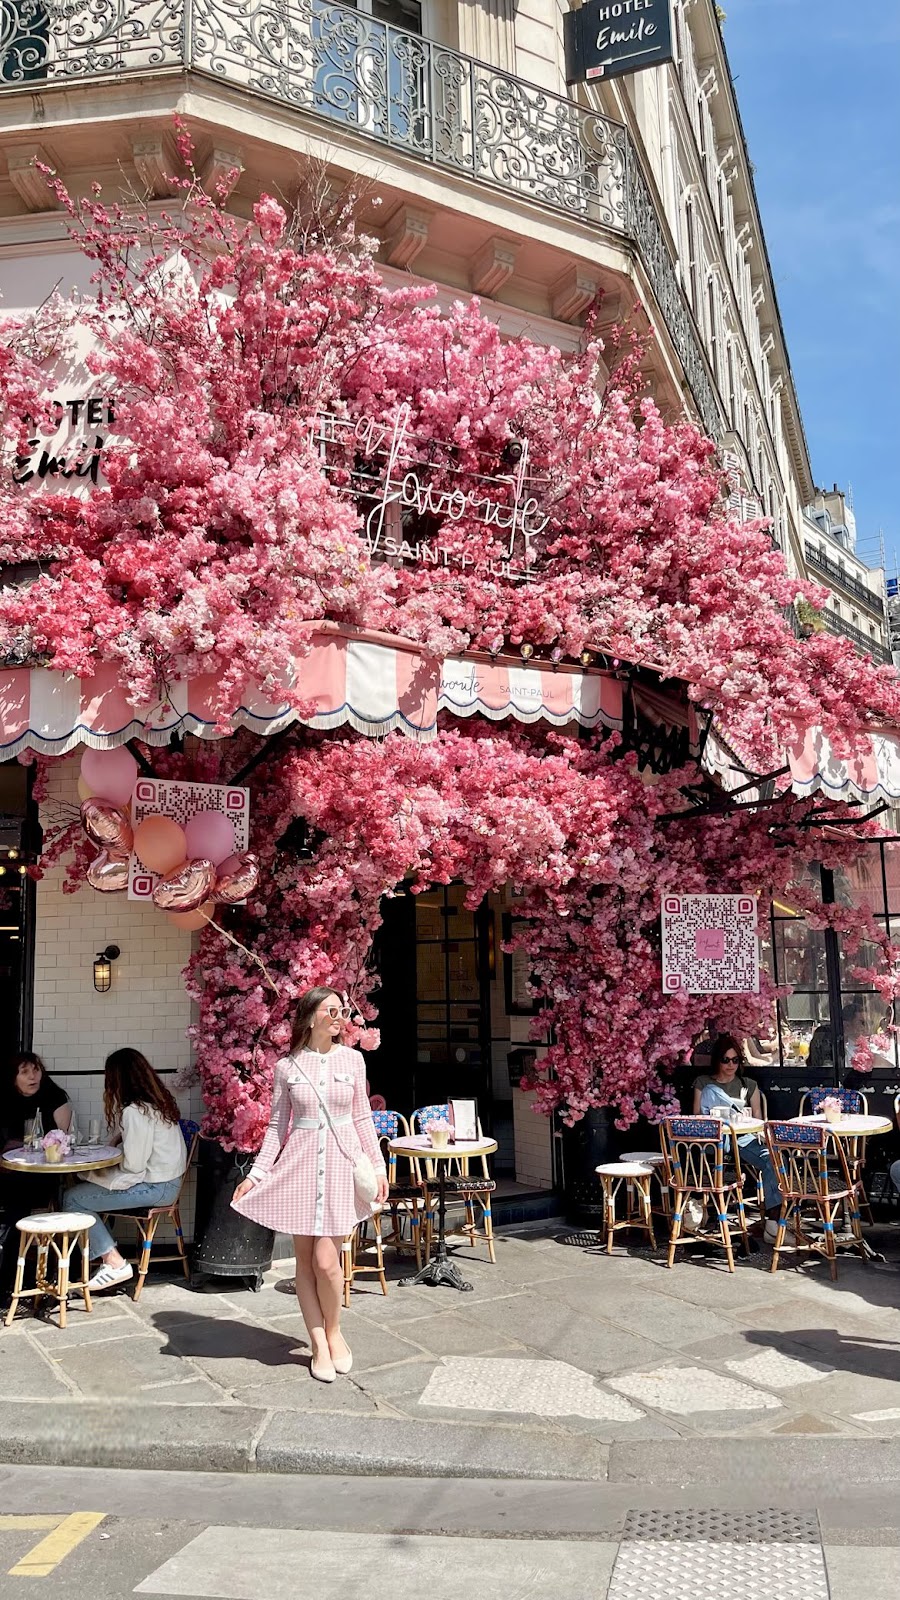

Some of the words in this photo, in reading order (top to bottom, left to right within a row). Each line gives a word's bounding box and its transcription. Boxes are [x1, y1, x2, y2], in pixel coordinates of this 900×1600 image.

[599, 0, 653, 20] HOTEL
[596, 17, 658, 50] Emile
[13, 435, 104, 485] Emil
[383, 536, 520, 581] SAINT-PAUL
[500, 685, 554, 698] SAINT-PAUL
